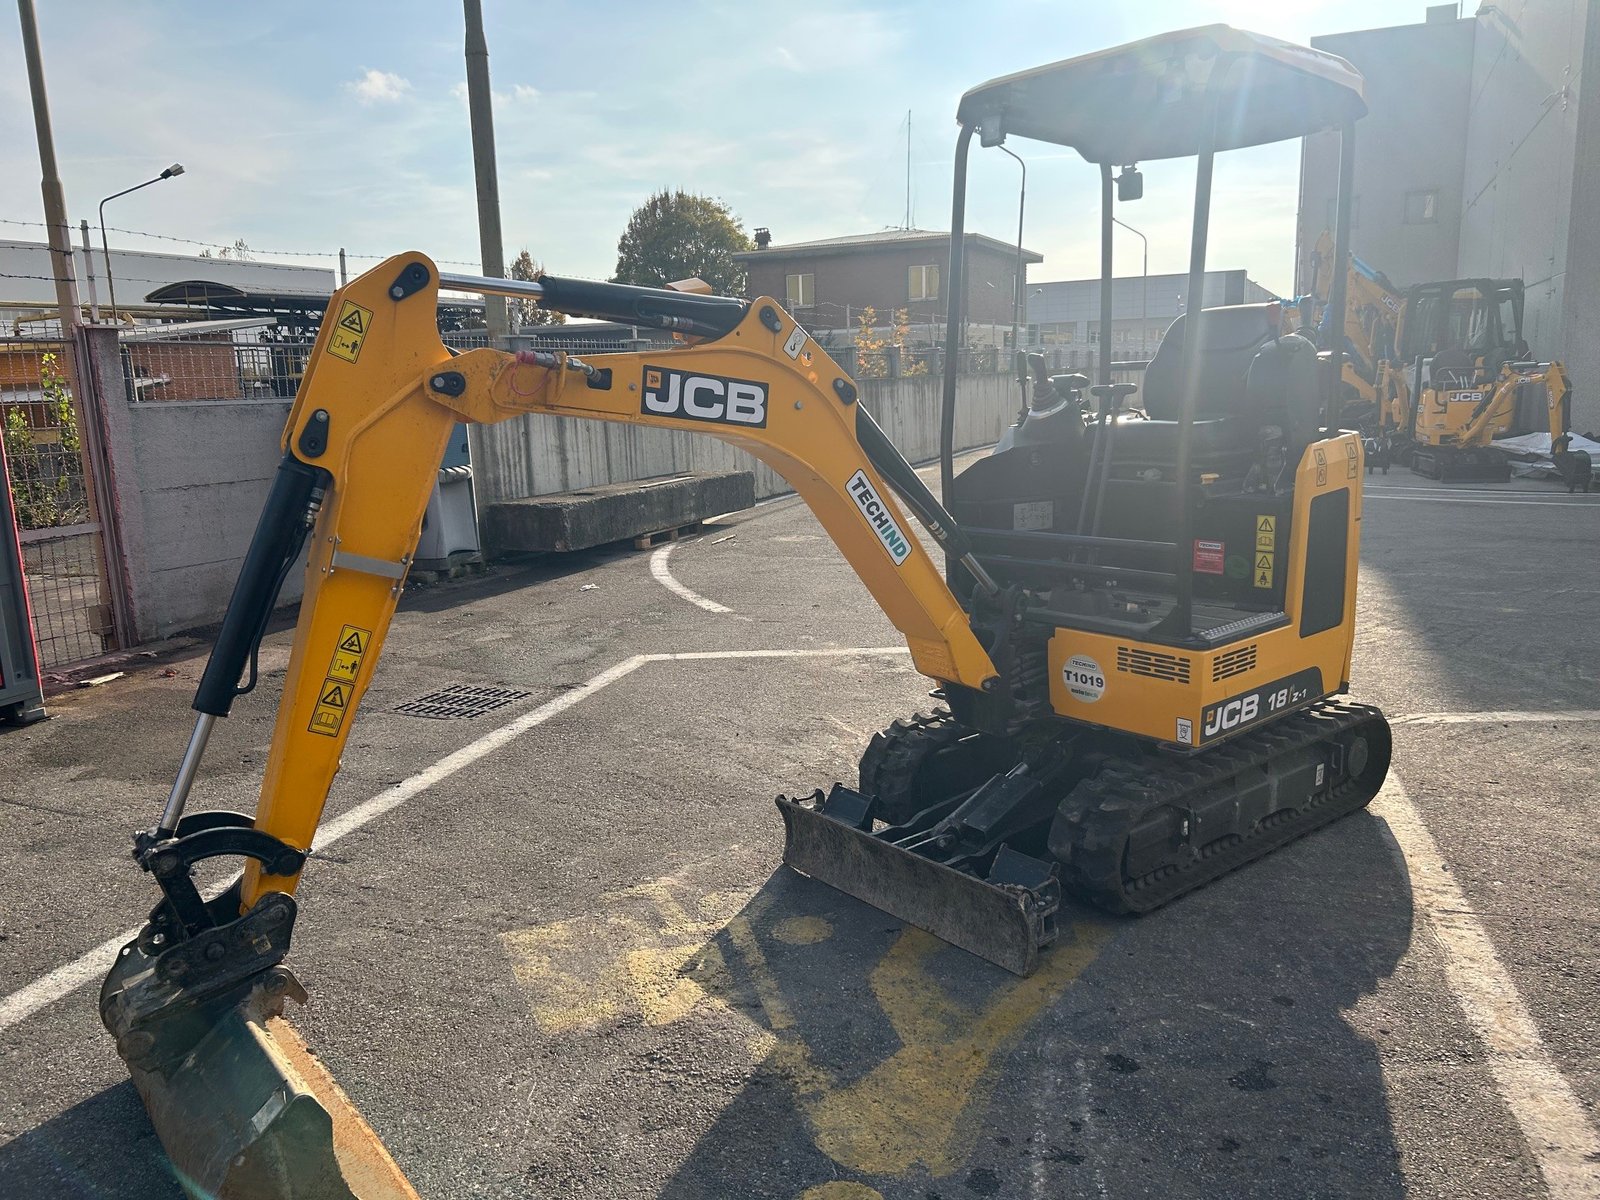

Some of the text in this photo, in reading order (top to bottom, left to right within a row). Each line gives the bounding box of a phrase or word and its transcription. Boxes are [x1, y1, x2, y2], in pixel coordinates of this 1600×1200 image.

[1380, 295, 1400, 314] JCB
[645, 373, 765, 424] JCB
[1450, 392, 1483, 402] JCB
[851, 476, 907, 558] TECHIND
[1072, 659, 1096, 669] TECHIND
[1064, 669, 1104, 689] T1019
[1204, 693, 1260, 736] JCB
